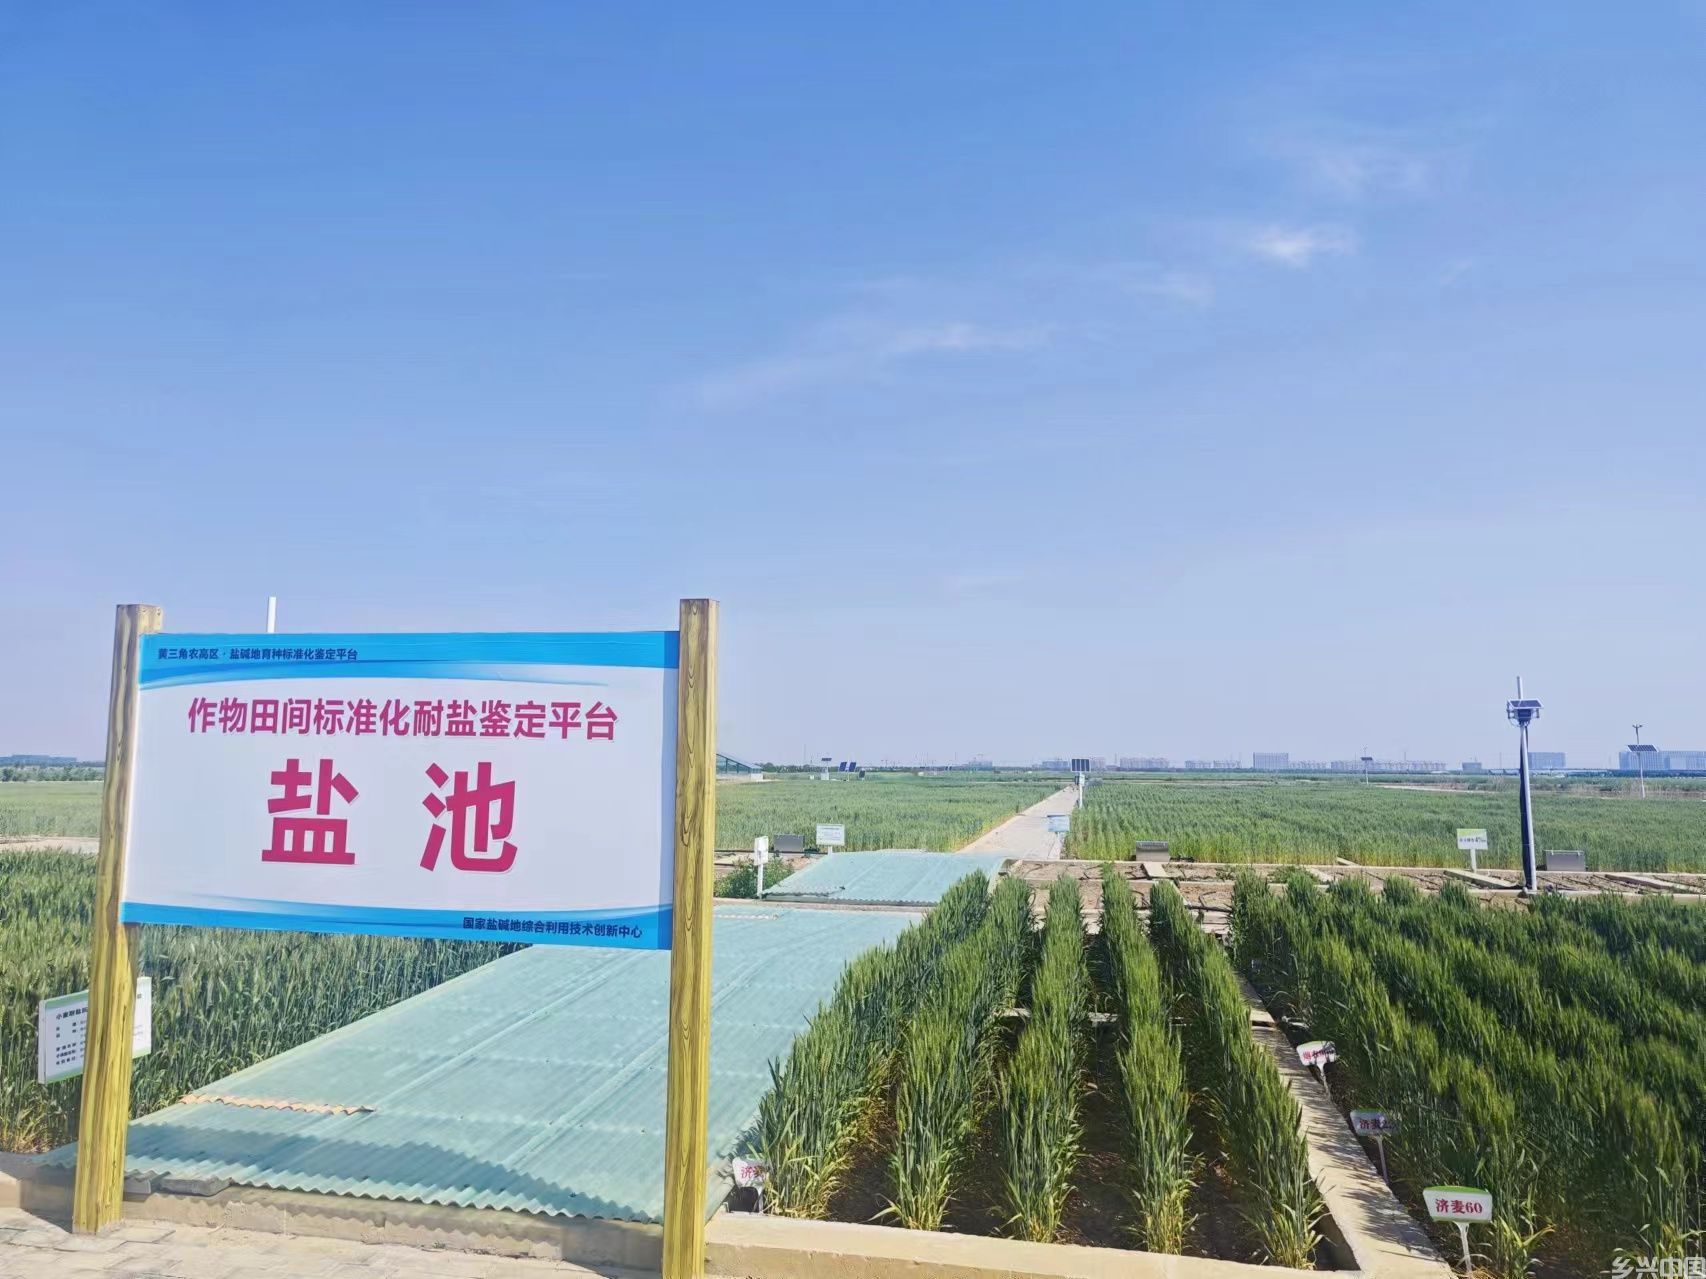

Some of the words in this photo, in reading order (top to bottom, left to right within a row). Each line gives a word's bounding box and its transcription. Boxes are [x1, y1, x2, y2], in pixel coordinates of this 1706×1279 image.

[188, 697, 618, 740] 作物田间标准化耐盐鉴定平台
[463, 916, 643, 938] 国家盐碱地综合利用技术创新中心
[1435, 1198, 1483, 1214] 济麦60
